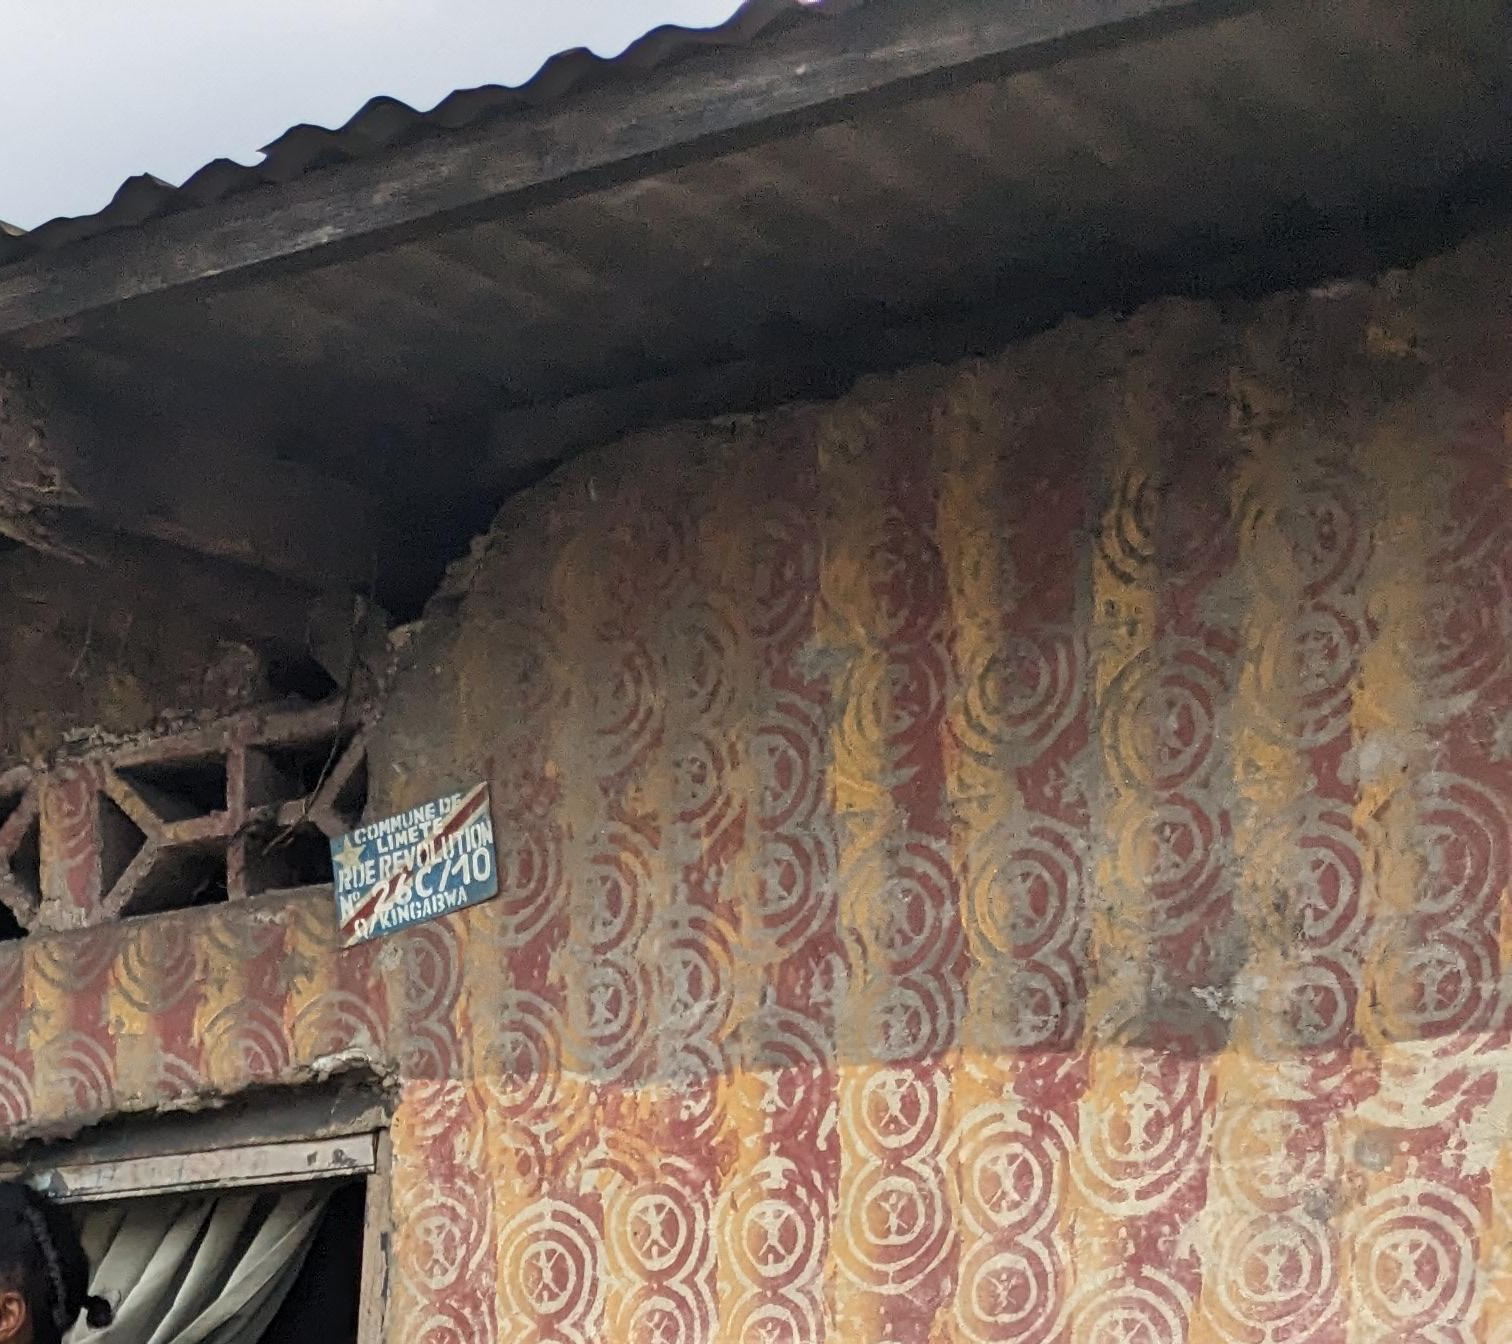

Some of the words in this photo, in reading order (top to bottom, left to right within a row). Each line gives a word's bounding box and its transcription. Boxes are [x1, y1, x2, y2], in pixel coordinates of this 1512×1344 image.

[354, 803, 435, 844] COMMUNE
[439, 793, 462, 815] DE
[376, 817, 444, 854] LIMETE
[338, 859, 376, 893] RUE
[379, 821, 493, 876] REVOLUTION
